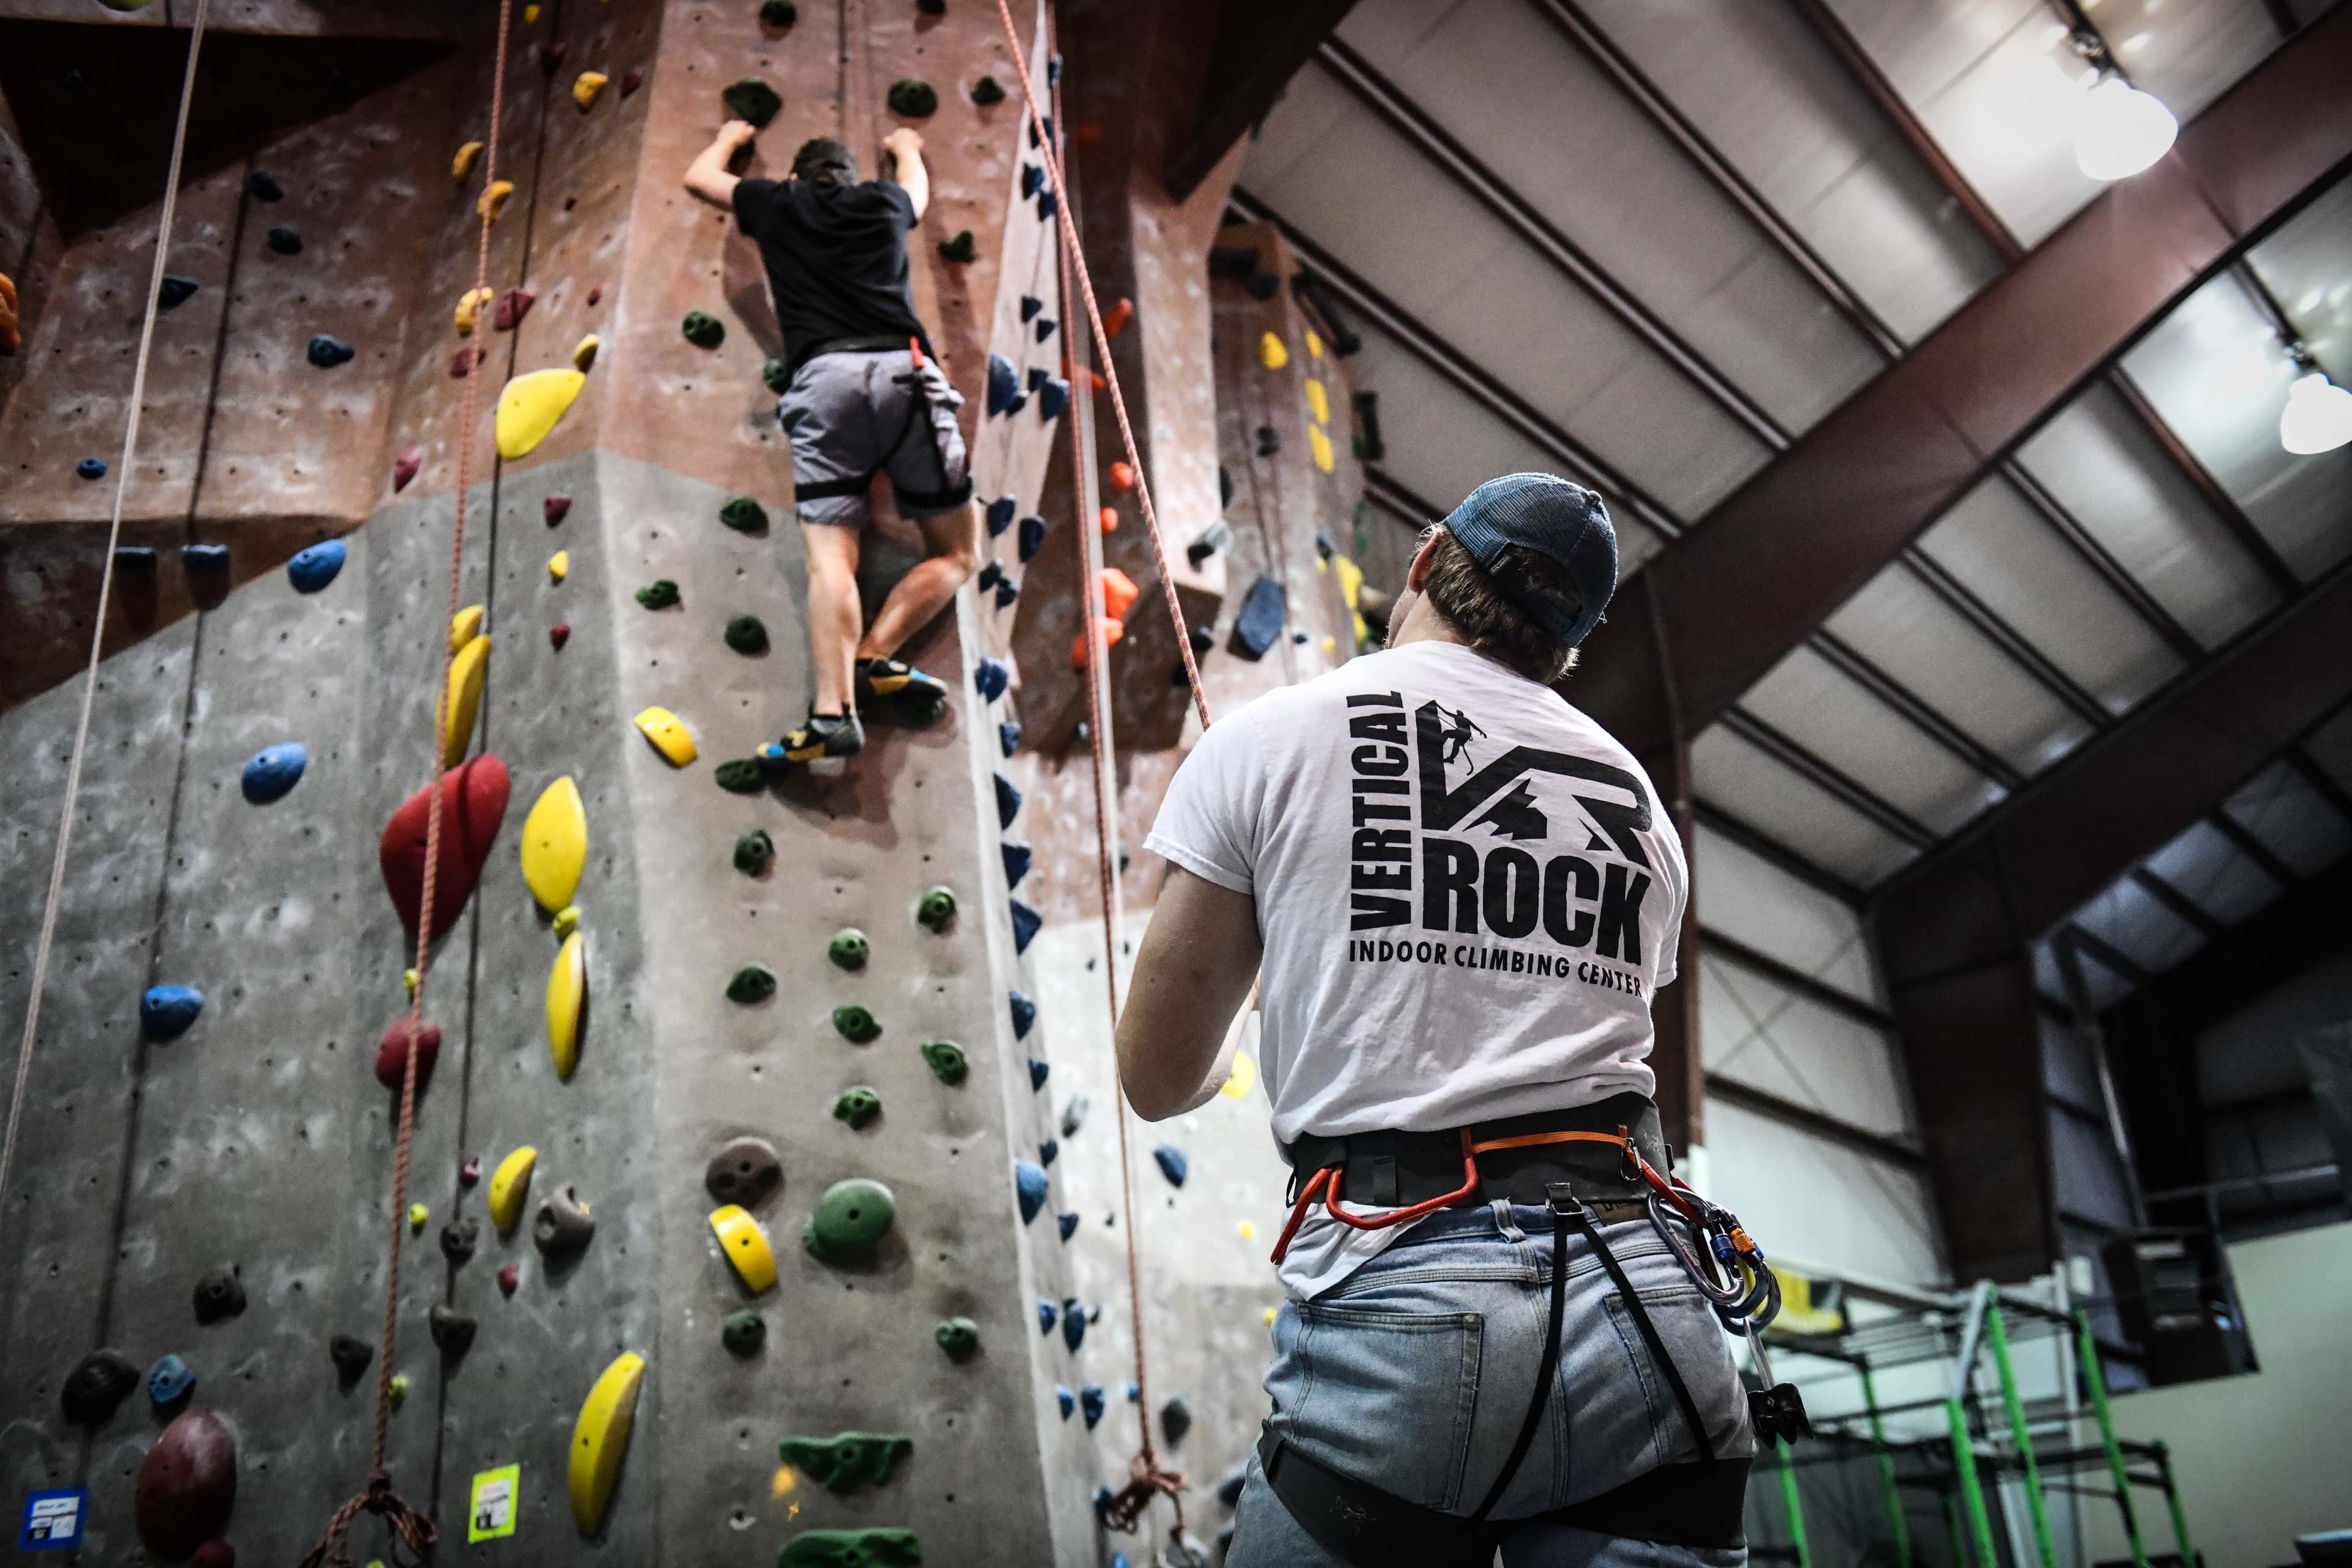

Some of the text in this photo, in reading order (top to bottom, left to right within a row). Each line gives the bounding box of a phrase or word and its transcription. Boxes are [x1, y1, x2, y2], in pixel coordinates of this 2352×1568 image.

[1346, 690, 1412, 932] VERTICAL
[1422, 837, 1652, 967] ROCK
[1349, 940, 1643, 998] INDOOR CLIMBING CENTER
